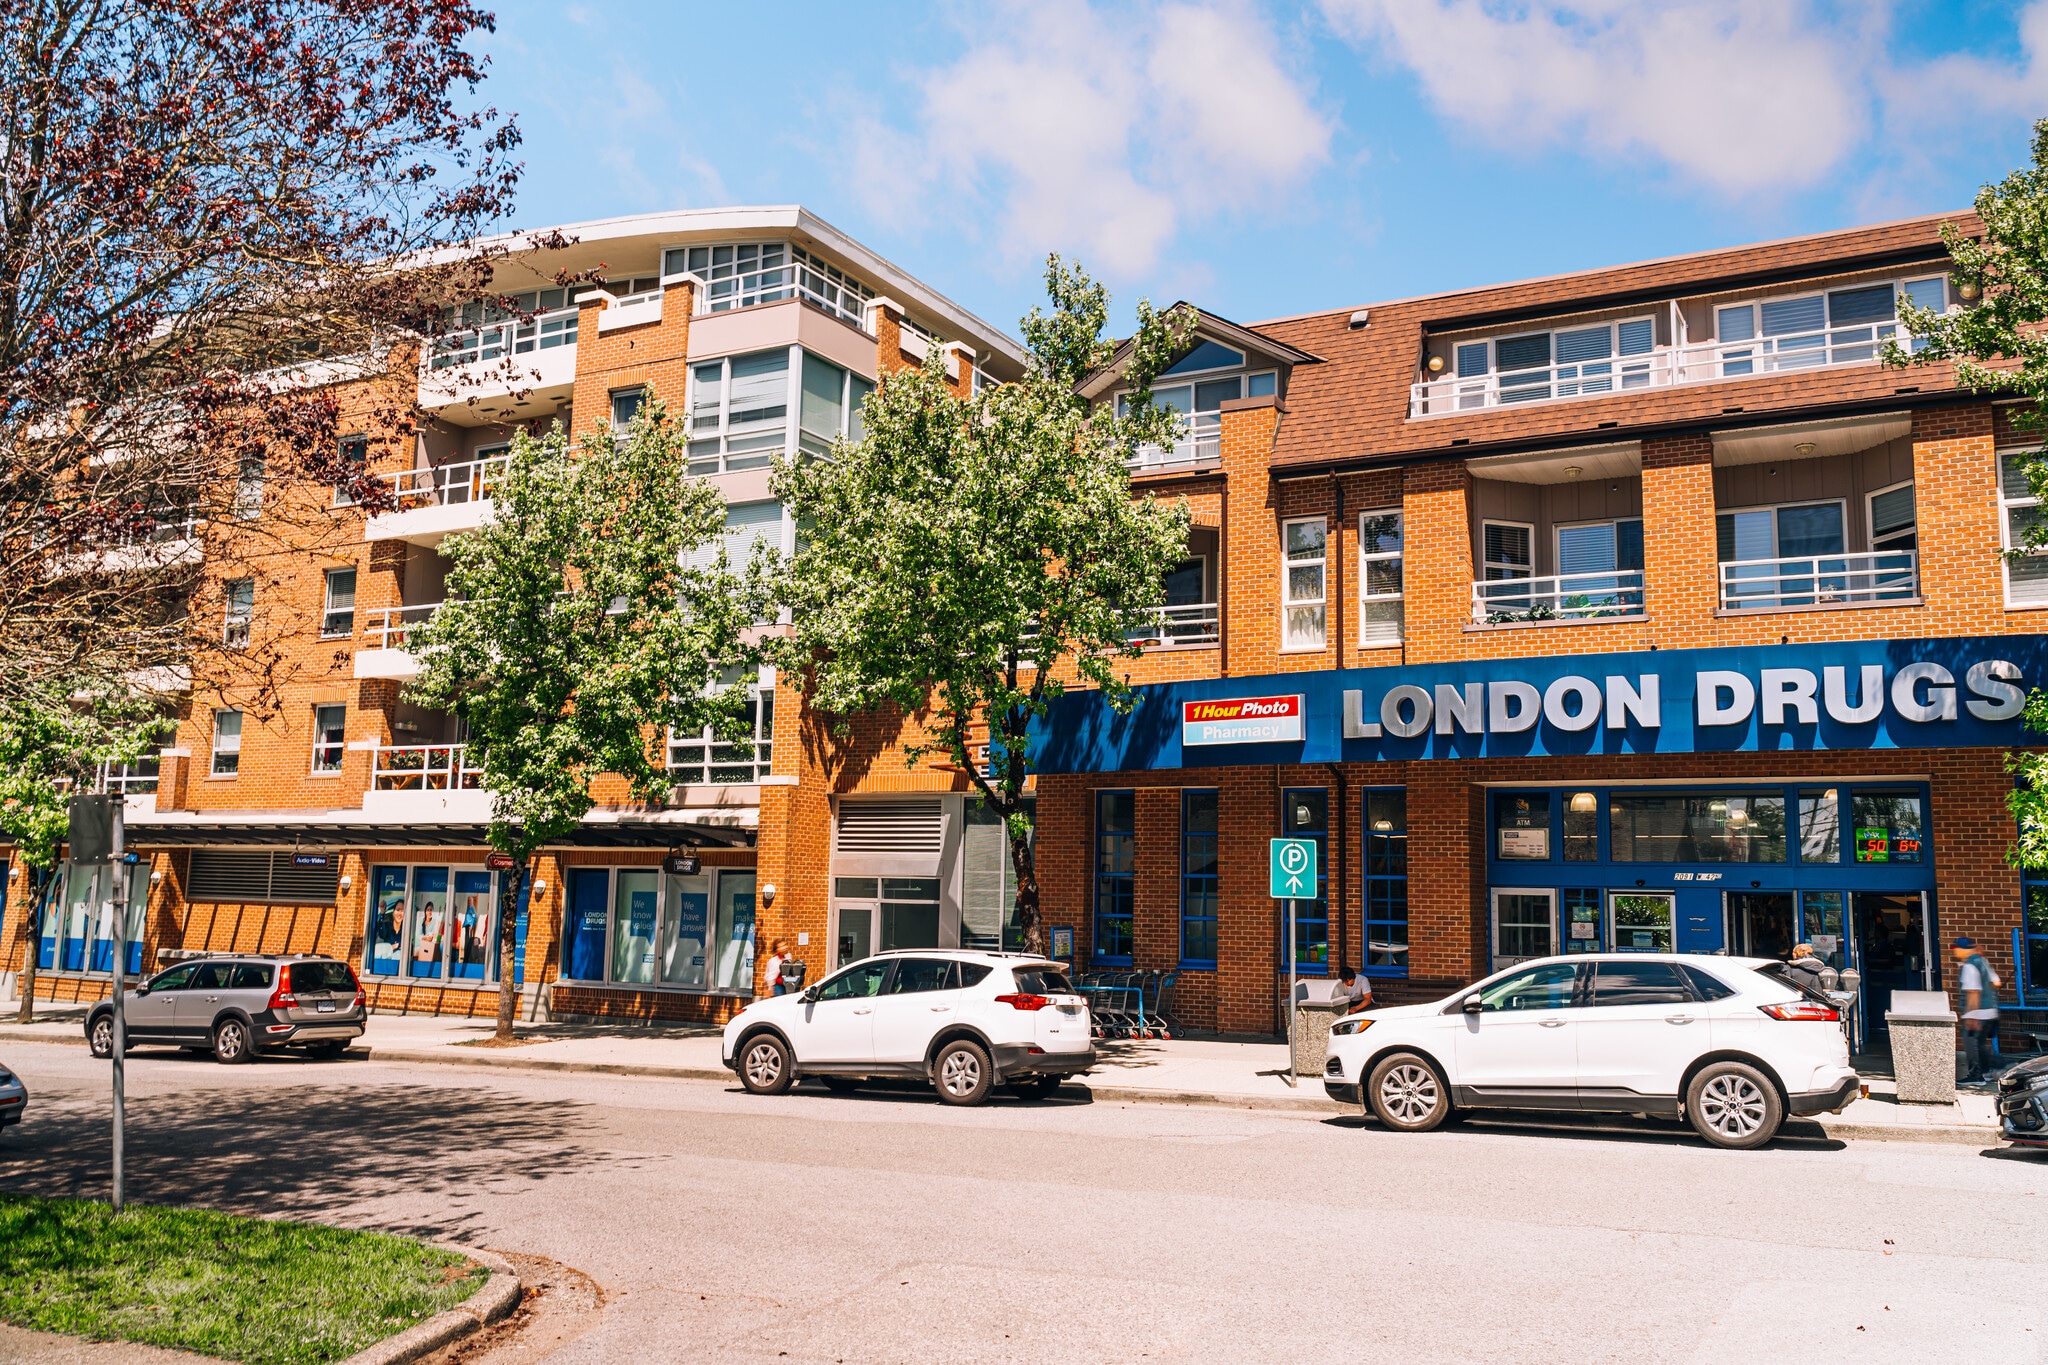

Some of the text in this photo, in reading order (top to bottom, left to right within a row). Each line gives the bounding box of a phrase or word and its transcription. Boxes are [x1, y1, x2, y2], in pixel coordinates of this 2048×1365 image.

[1343, 659, 2026, 738] LONDON DRUGS
[1193, 701, 1290, 719] 1 Hour Photo
[1203, 725, 1280, 739] Pharmacy
[1868, 840, 1887, 852] 50
[1899, 840, 1919, 852] 64
[633, 901, 645, 909] We
[684, 902, 694, 910] We
[736, 903, 747, 911] We
[633, 910, 652, 919] know
